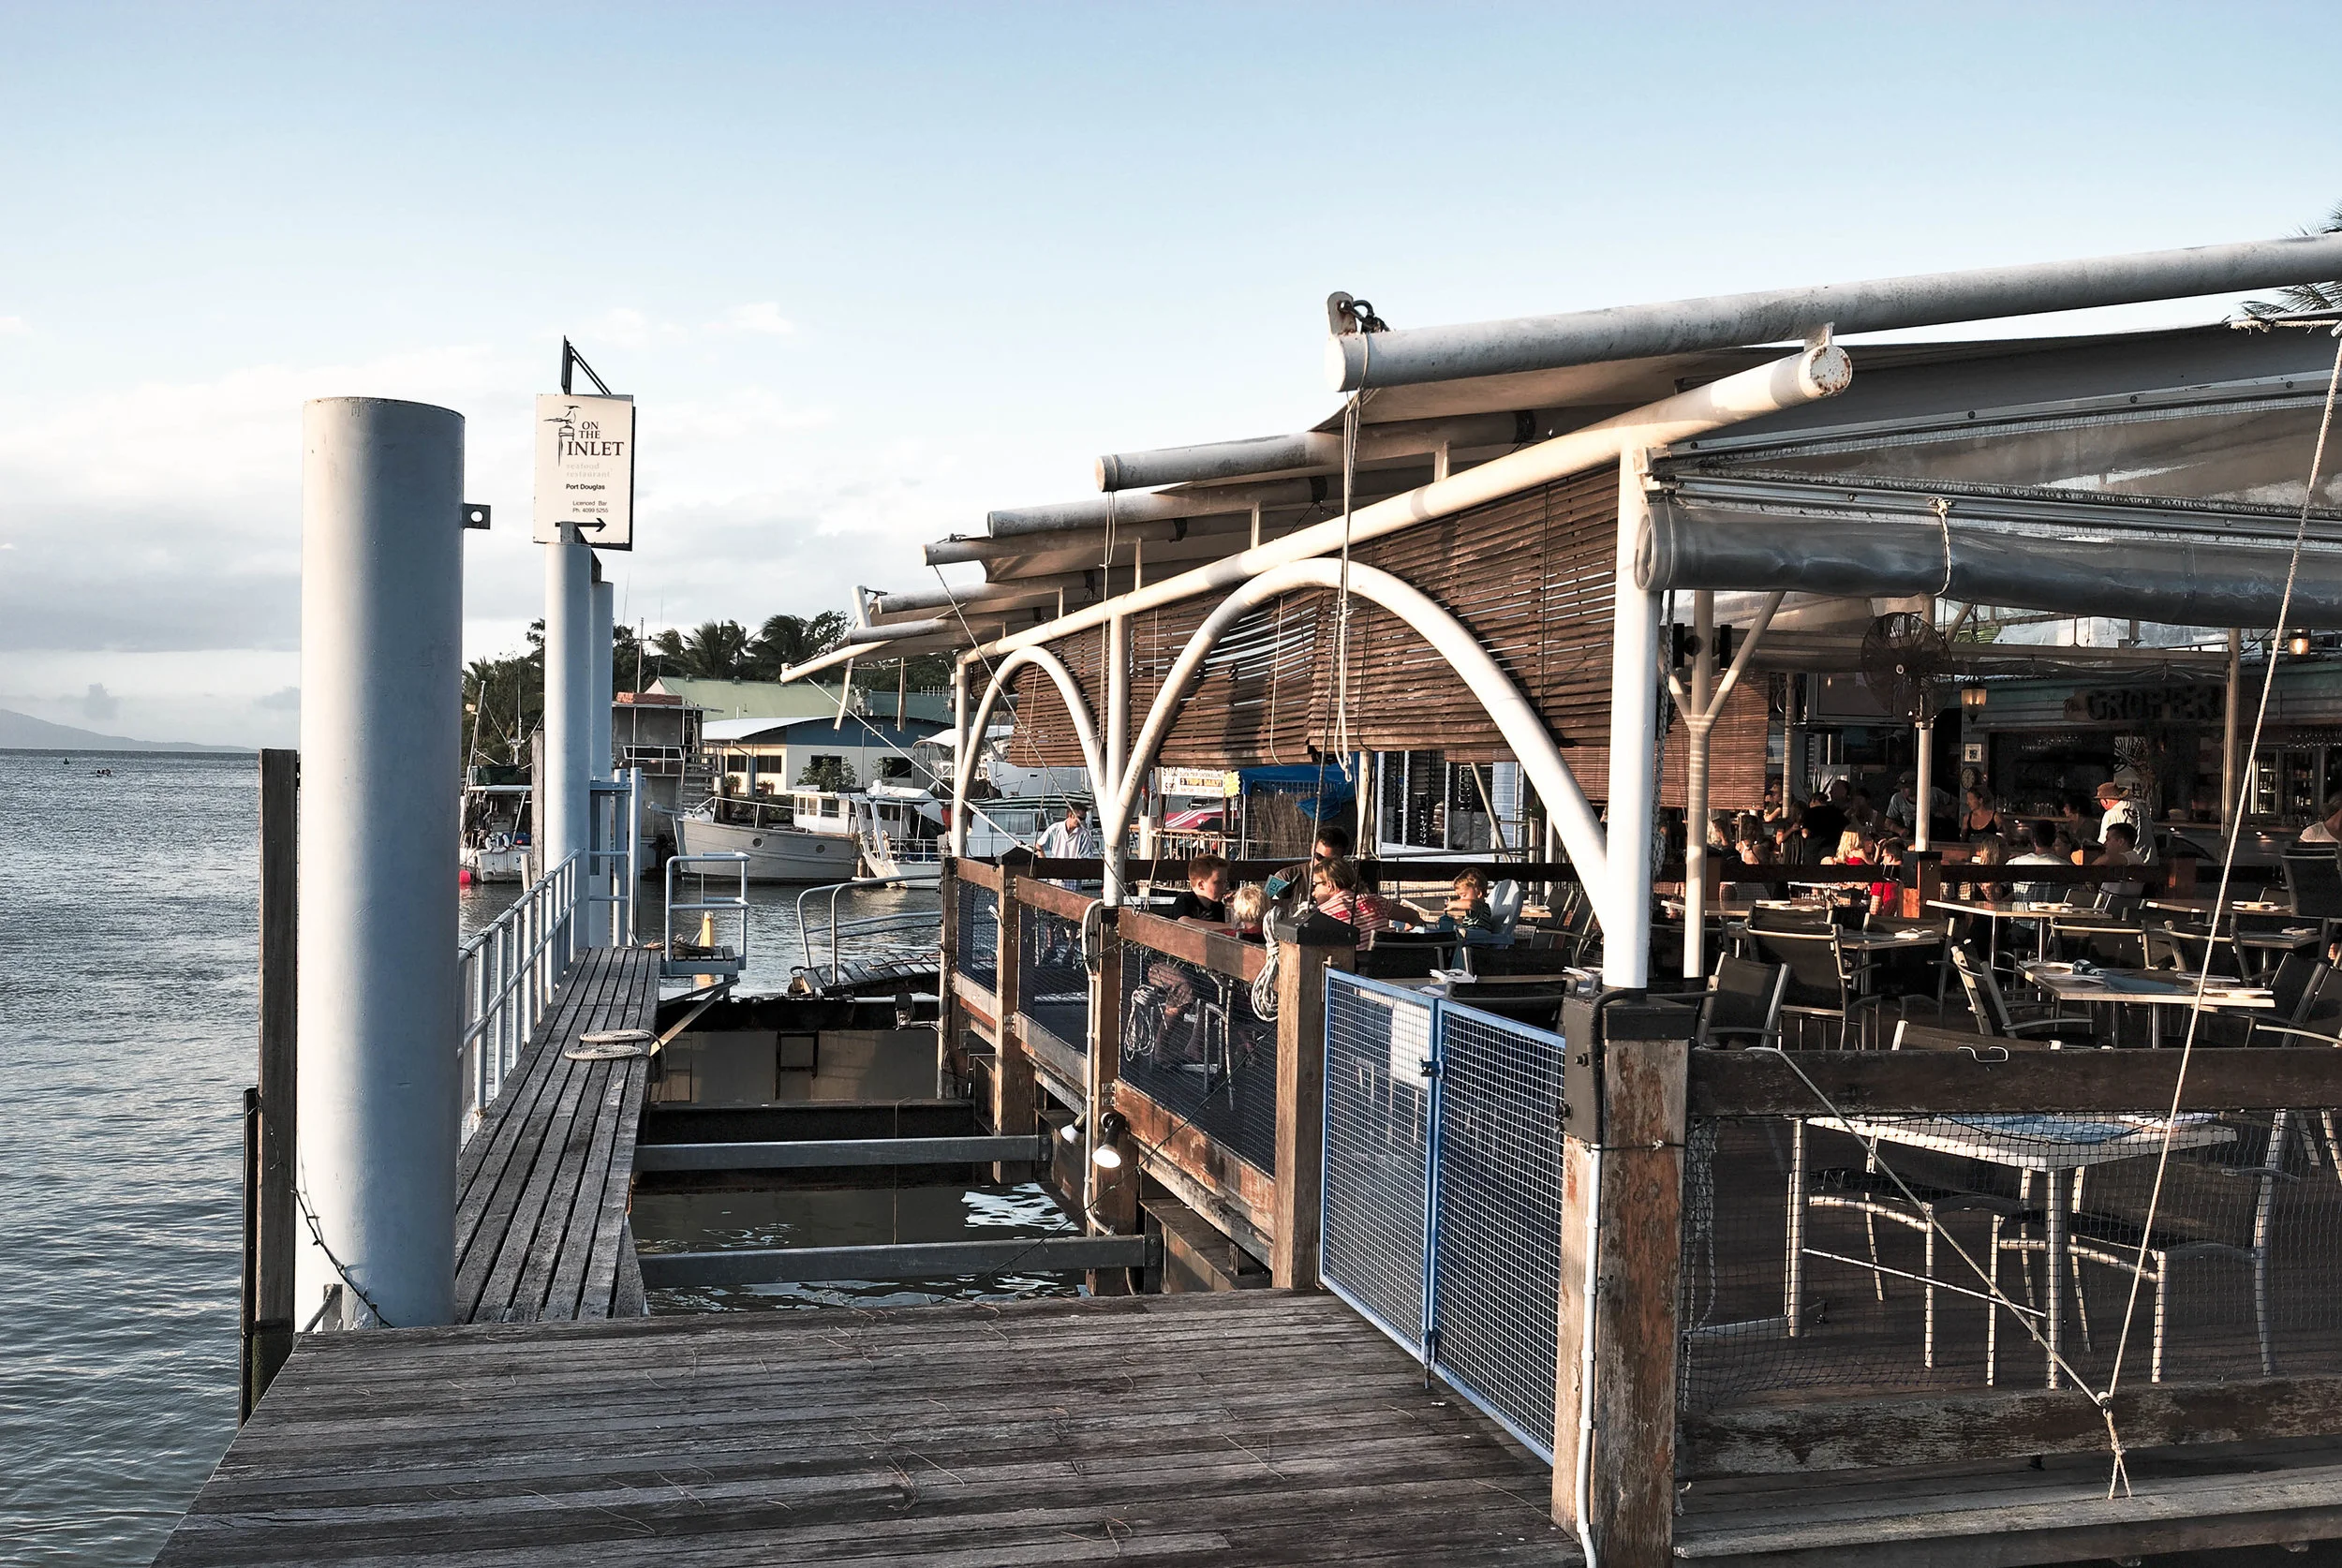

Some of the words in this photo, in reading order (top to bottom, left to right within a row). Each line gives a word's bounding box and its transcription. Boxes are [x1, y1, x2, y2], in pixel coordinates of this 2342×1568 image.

[582, 422, 599, 430] ON
[579, 430, 600, 439] THE
[567, 441, 625, 456] INLET
